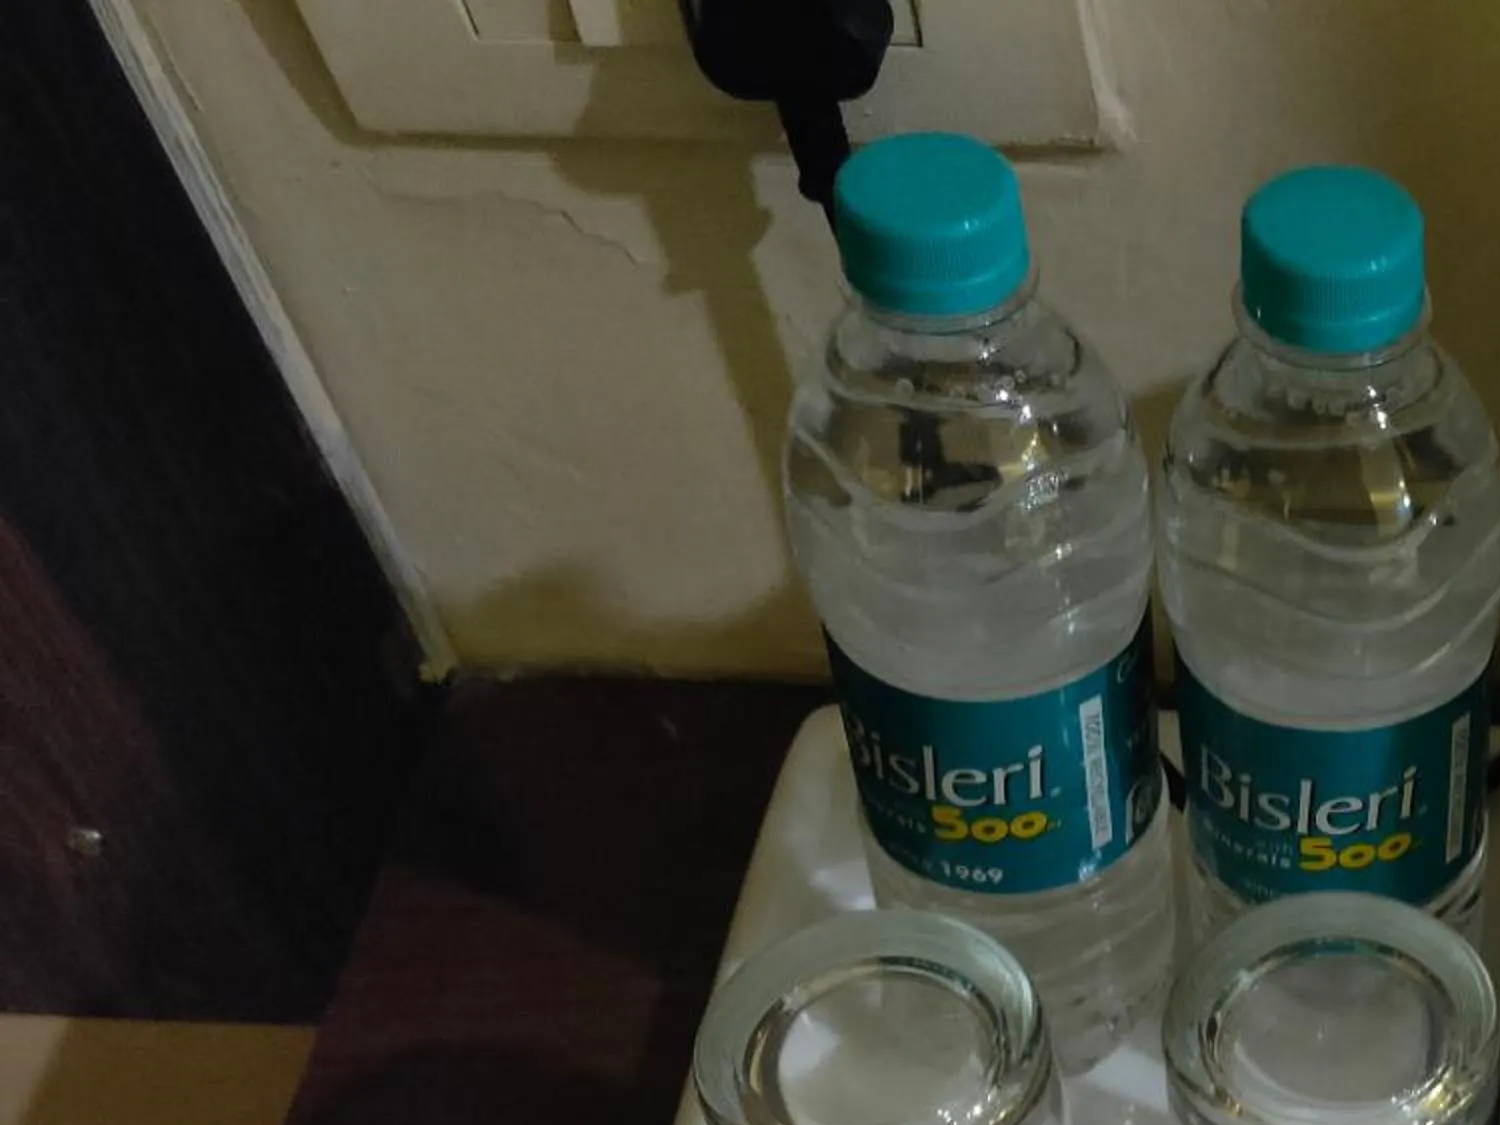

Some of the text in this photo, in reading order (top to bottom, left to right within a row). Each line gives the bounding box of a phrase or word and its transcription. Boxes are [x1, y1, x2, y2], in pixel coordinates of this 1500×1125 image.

[1200, 744, 1417, 836] Bisleri
[931, 805, 1047, 843] 500
[1300, 833, 1412, 871] 500
[943, 863, 1004, 884] 1969
